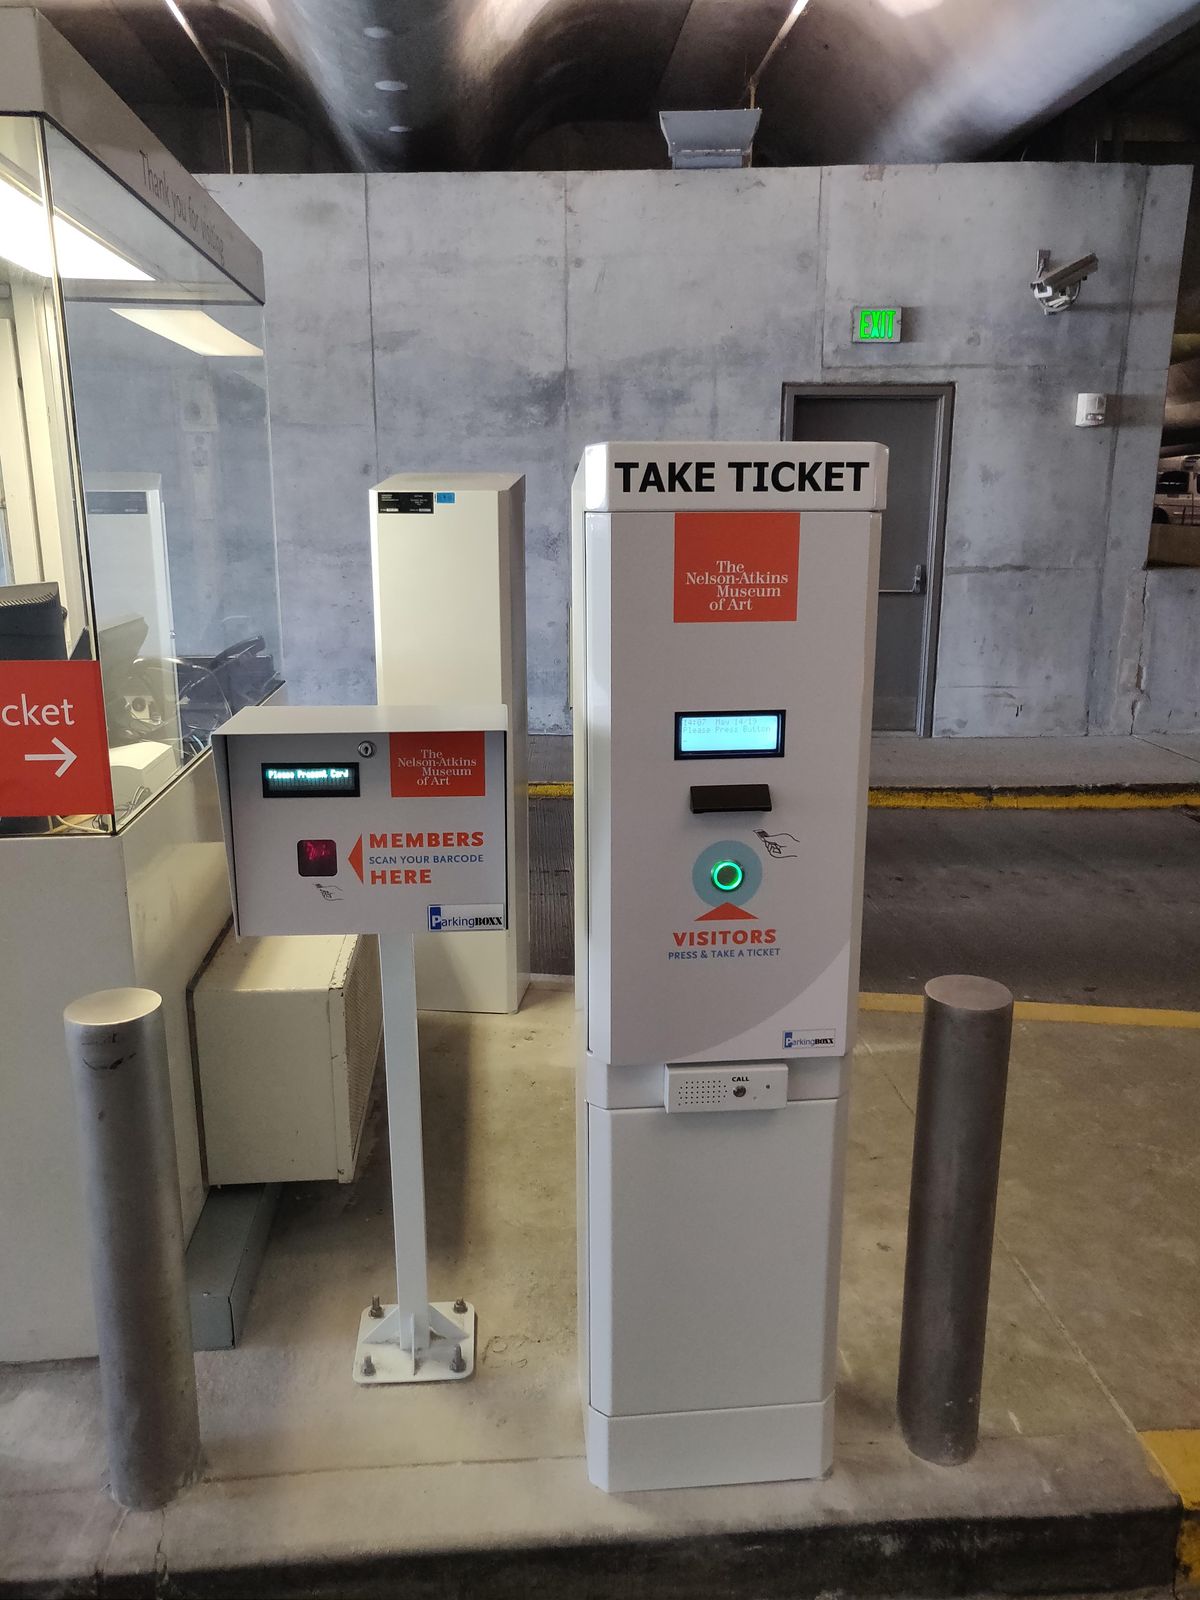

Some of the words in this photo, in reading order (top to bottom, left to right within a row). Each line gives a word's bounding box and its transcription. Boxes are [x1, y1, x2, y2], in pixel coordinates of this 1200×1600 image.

[139, 149, 170, 208] Thank
[171, 190, 187, 224] you
[188, 196, 199, 232] for
[860, 310, 896, 339] EXIT
[614, 462, 715, 493] TAKE
[728, 461, 870, 492] TICKET
[716, 560, 745, 574] The
[685, 571, 789, 585] Nelson-Atkins
[716, 585, 781, 598] Museum
[709, 598, 726, 611] of
[726, 598, 753, 611] Art
[683, 726, 711, 734] Please
[714, 725, 738, 733] Press
[742, 724, 771, 733] Button
[420, 749, 443, 759] The
[397, 757, 477, 768] Nelson-Atkins
[422, 766, 472, 776] Museum
[416, 776, 430, 786] of
[430, 776, 450, 786] Art
[369, 832, 484, 848] MEMBERS
[369, 856, 397, 865] SCAN
[400, 855, 430, 864] YOUR
[433, 854, 484, 864] BARCODE
[370, 869, 432, 885] HERE
[673, 929, 777, 947] VISITORS
[668, 951, 698, 960] PRESS
[700, 950, 708, 959] &
[711, 949, 735, 958] TAKE
[737, 949, 745, 957] A
[747, 948, 780, 957] TICKET
